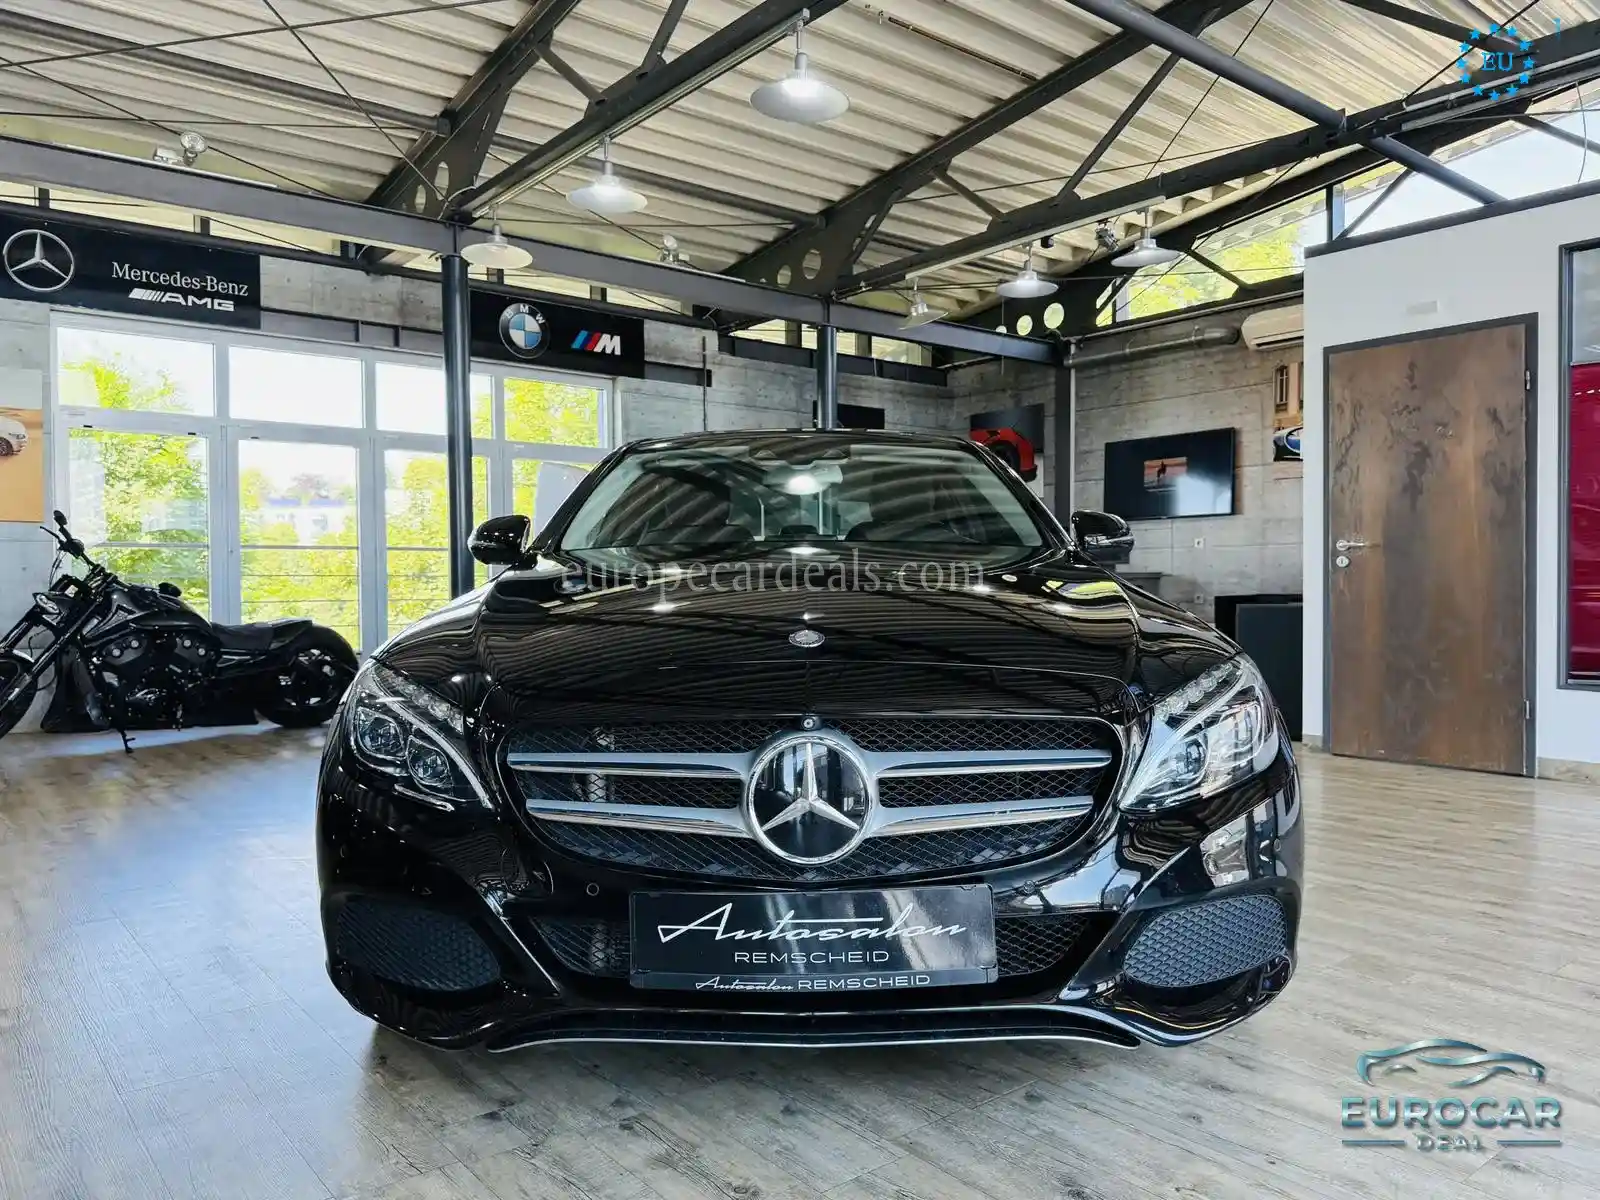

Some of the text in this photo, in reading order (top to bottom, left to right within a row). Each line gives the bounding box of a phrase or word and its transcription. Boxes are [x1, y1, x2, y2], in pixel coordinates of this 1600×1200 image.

[111, 261, 249, 297] Mercedes-Benz
[161, 292, 235, 311] AMG
[504, 304, 546, 325] BMW
[657, 902, 966, 943] Autosalon
[734, 951, 889, 964] REMSCHEID
[695, 974, 931, 991] Autosalon REMSCHEID
